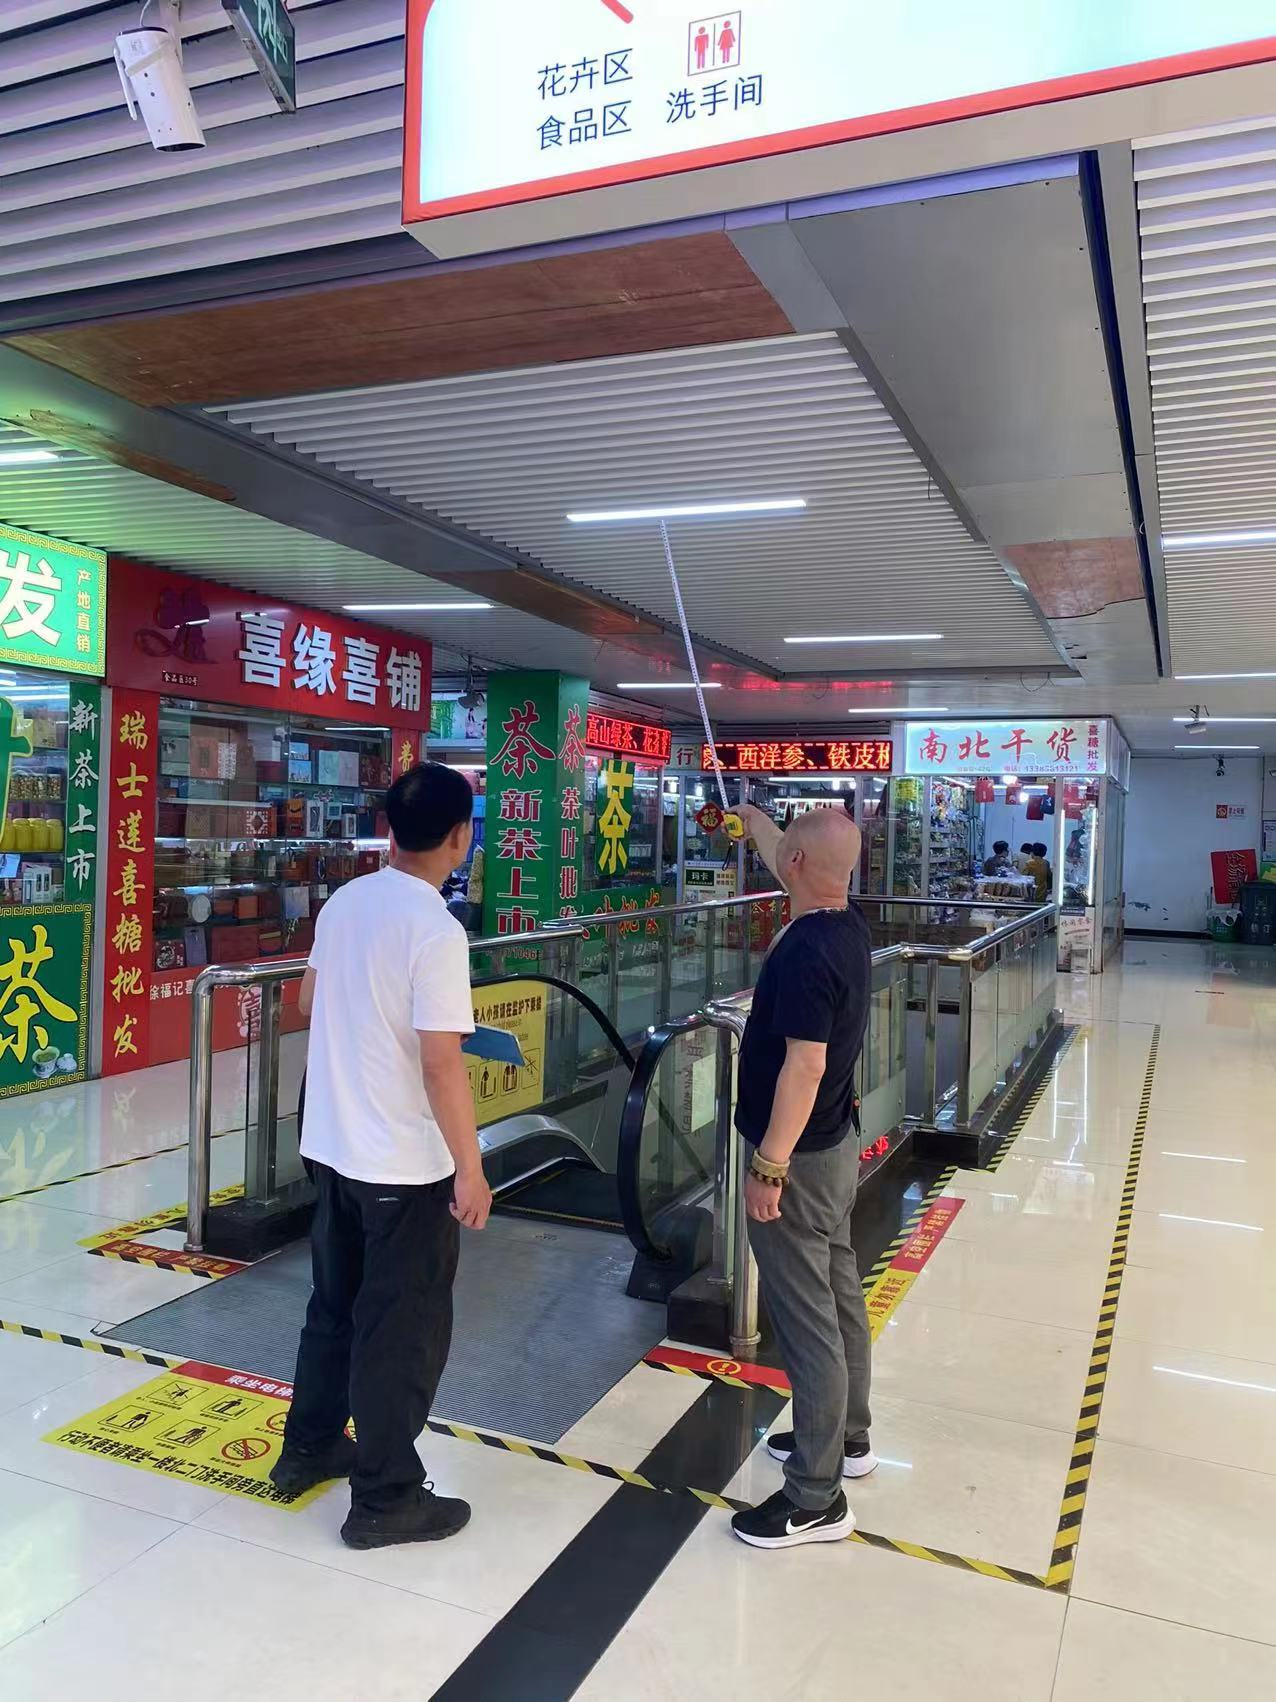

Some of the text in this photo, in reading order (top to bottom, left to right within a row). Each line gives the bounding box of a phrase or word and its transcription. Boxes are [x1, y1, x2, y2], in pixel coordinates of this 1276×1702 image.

[537, 48, 633, 100] 花卉区
[666, 74, 763, 124] 洗手间
[537, 100, 632, 151] 食品区
[0, 550, 63, 648] 发
[76, 568, 92, 653] 产地直销
[239, 612, 422, 713] 喜缘喜铺
[490, 700, 556, 780] 茶
[559, 704, 585, 773] 茶
[920, 727, 1077, 764] 南北干货
[1087, 725, 1099, 772] 喜糖批发
[66, 699, 99, 890] 新茶上市
[598, 759, 634, 875] 茶
[495, 788, 543, 935] 新茶上市
[0, 924, 78, 1064] 茶
